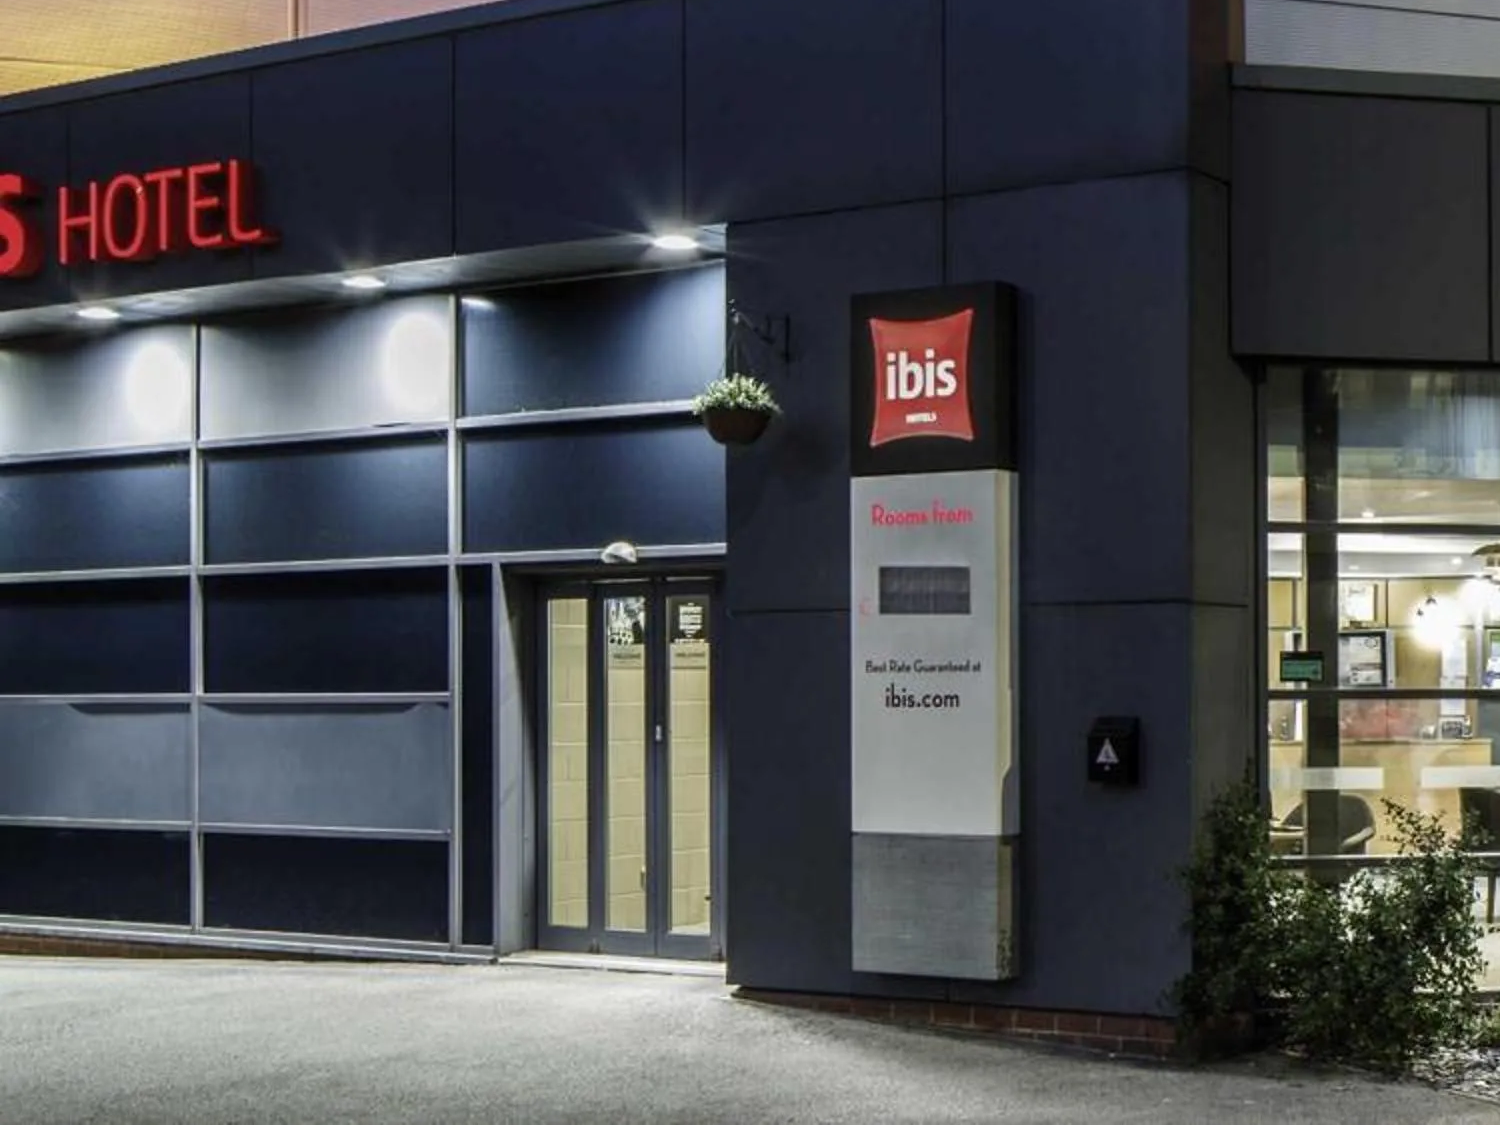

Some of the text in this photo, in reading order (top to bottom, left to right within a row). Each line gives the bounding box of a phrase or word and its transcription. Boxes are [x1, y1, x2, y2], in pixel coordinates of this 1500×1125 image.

[57, 159, 262, 265] HOTEL
[886, 348, 957, 400] ibis
[871, 497, 974, 525] Rooms from
[865, 659, 981, 673] Best Rate Guaranteed at
[885, 683, 960, 708] ibis.com
